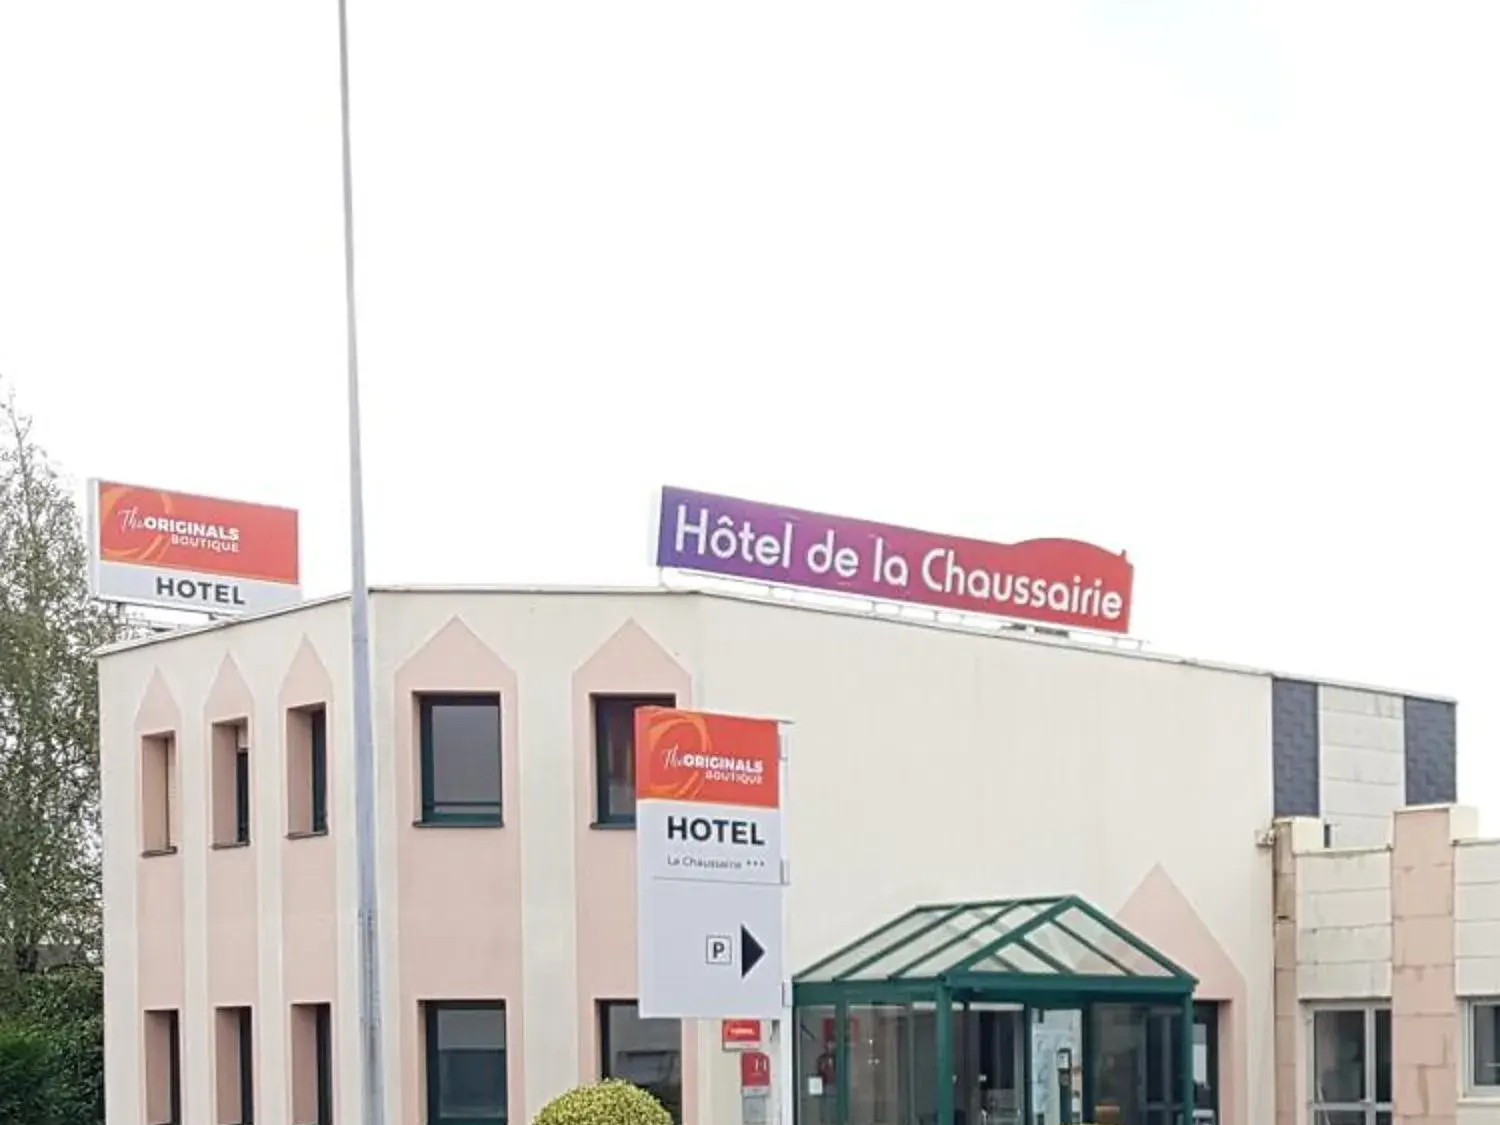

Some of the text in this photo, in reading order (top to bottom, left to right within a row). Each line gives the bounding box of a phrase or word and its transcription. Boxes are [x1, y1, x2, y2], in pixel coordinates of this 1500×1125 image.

[171, 534, 239, 553] BOUTIQUE
[674, 504, 1123, 620] Hôtel de la Chaussairie
[156, 576, 245, 605] HOTEL
[667, 815, 765, 846] HOTEL
